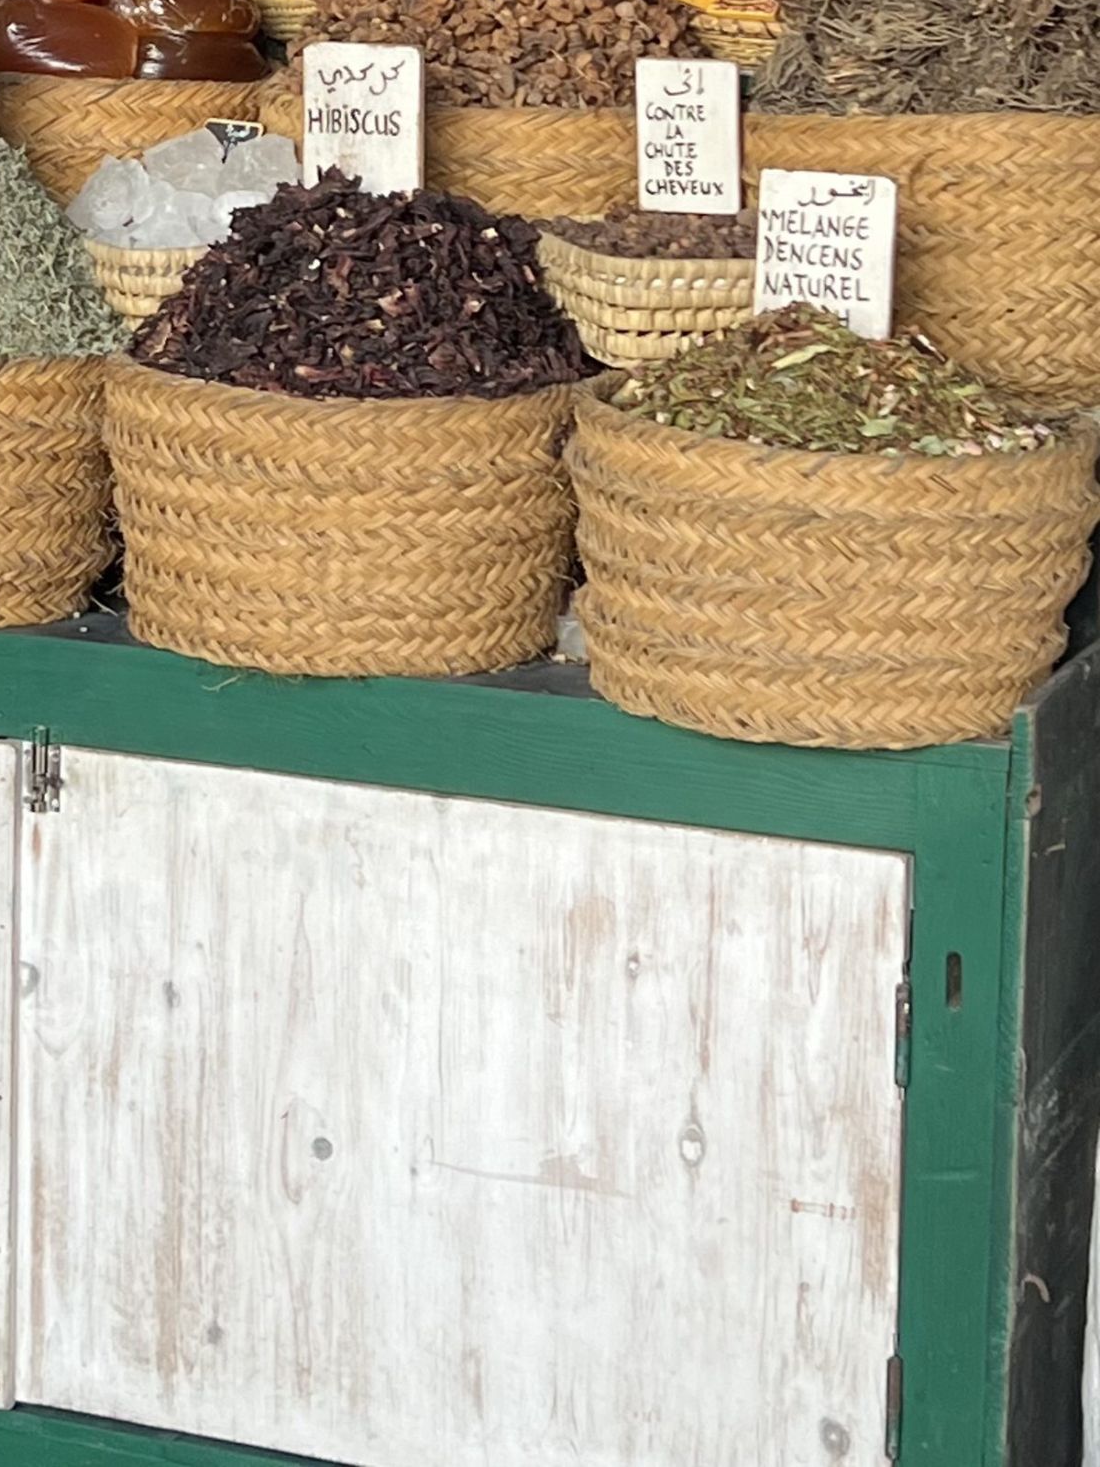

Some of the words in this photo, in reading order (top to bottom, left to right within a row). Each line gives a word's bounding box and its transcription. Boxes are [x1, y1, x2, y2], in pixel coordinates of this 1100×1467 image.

[307, 103, 403, 137] HIBISCUS
[645, 101, 707, 122] CONTRE
[665, 122, 685, 140] LA
[644, 141, 699, 160] CHUTE
[663, 159, 695, 178] DES
[644, 178, 725, 197] CHEVEUX
[762, 271, 871, 302] NATUREL
